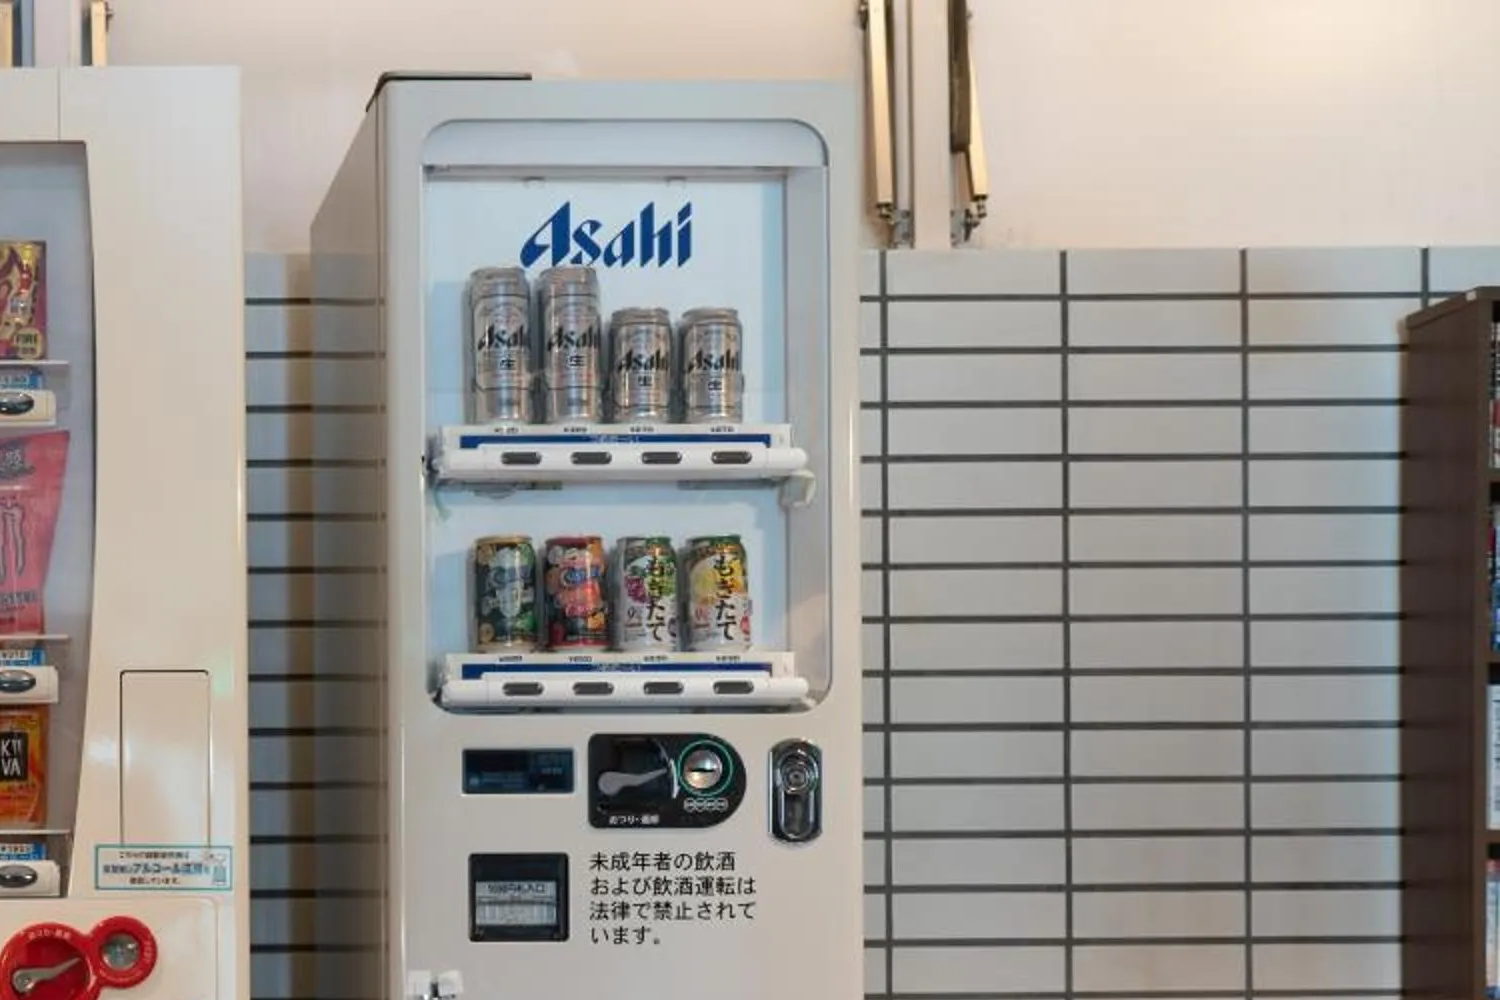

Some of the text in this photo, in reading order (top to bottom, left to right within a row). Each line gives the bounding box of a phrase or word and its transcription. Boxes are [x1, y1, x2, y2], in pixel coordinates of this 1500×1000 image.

[519, 200, 693, 269] Asahi
[590, 851, 737, 872] 未成年者の飲酒
[590, 876, 757, 897] および飲酒運転は
[589, 901, 756, 921] 法律で禁止されて
[590, 926, 661, 946] います。
